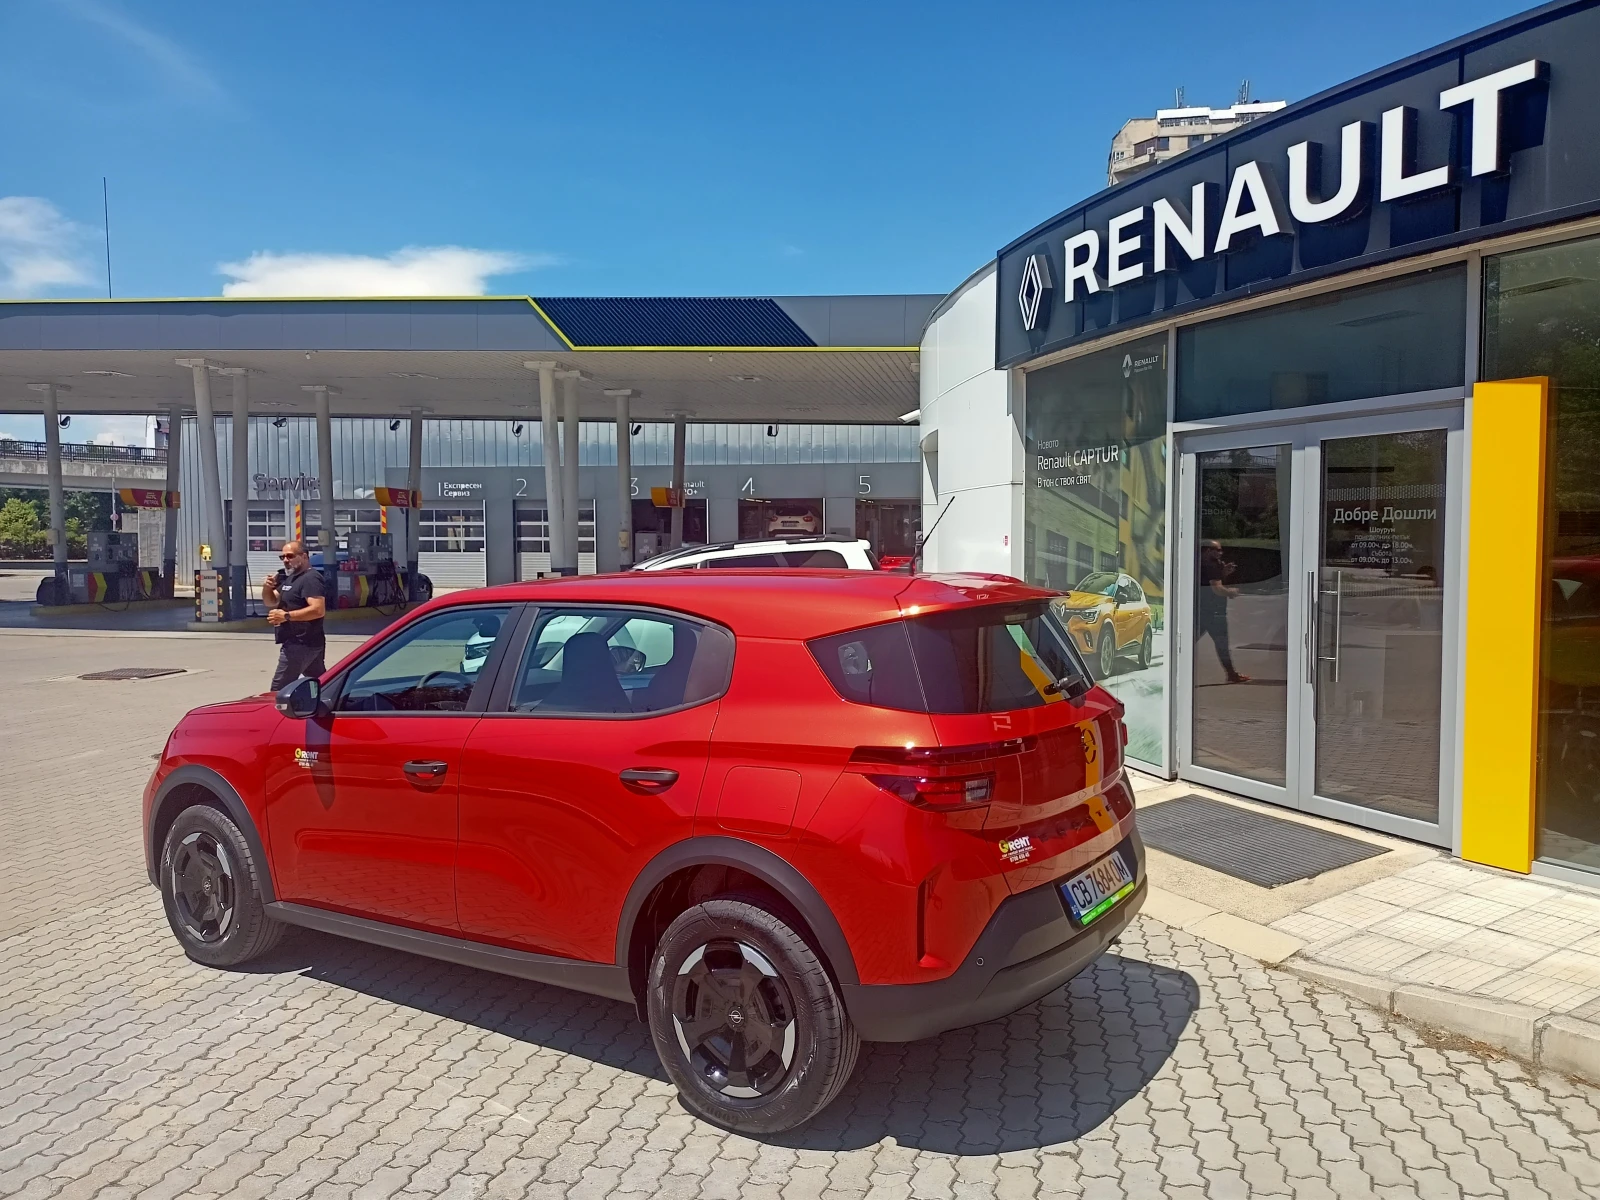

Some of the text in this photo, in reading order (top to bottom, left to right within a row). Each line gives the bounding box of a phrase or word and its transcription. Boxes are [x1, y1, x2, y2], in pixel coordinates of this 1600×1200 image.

[1064, 58, 1540, 303] RENAULT
[1134, 355, 1159, 366] RENAULT
[1037, 445, 1119, 471] Renault CAPTUR
[443, 481, 483, 491] Експресен
[443, 490, 471, 498] Сервиз
[515, 478, 528, 497] 2
[630, 477, 639, 496] 3
[741, 476, 756, 496] 4
[858, 475, 872, 495] 5
[1333, 506, 1437, 524] Добре Дошли
